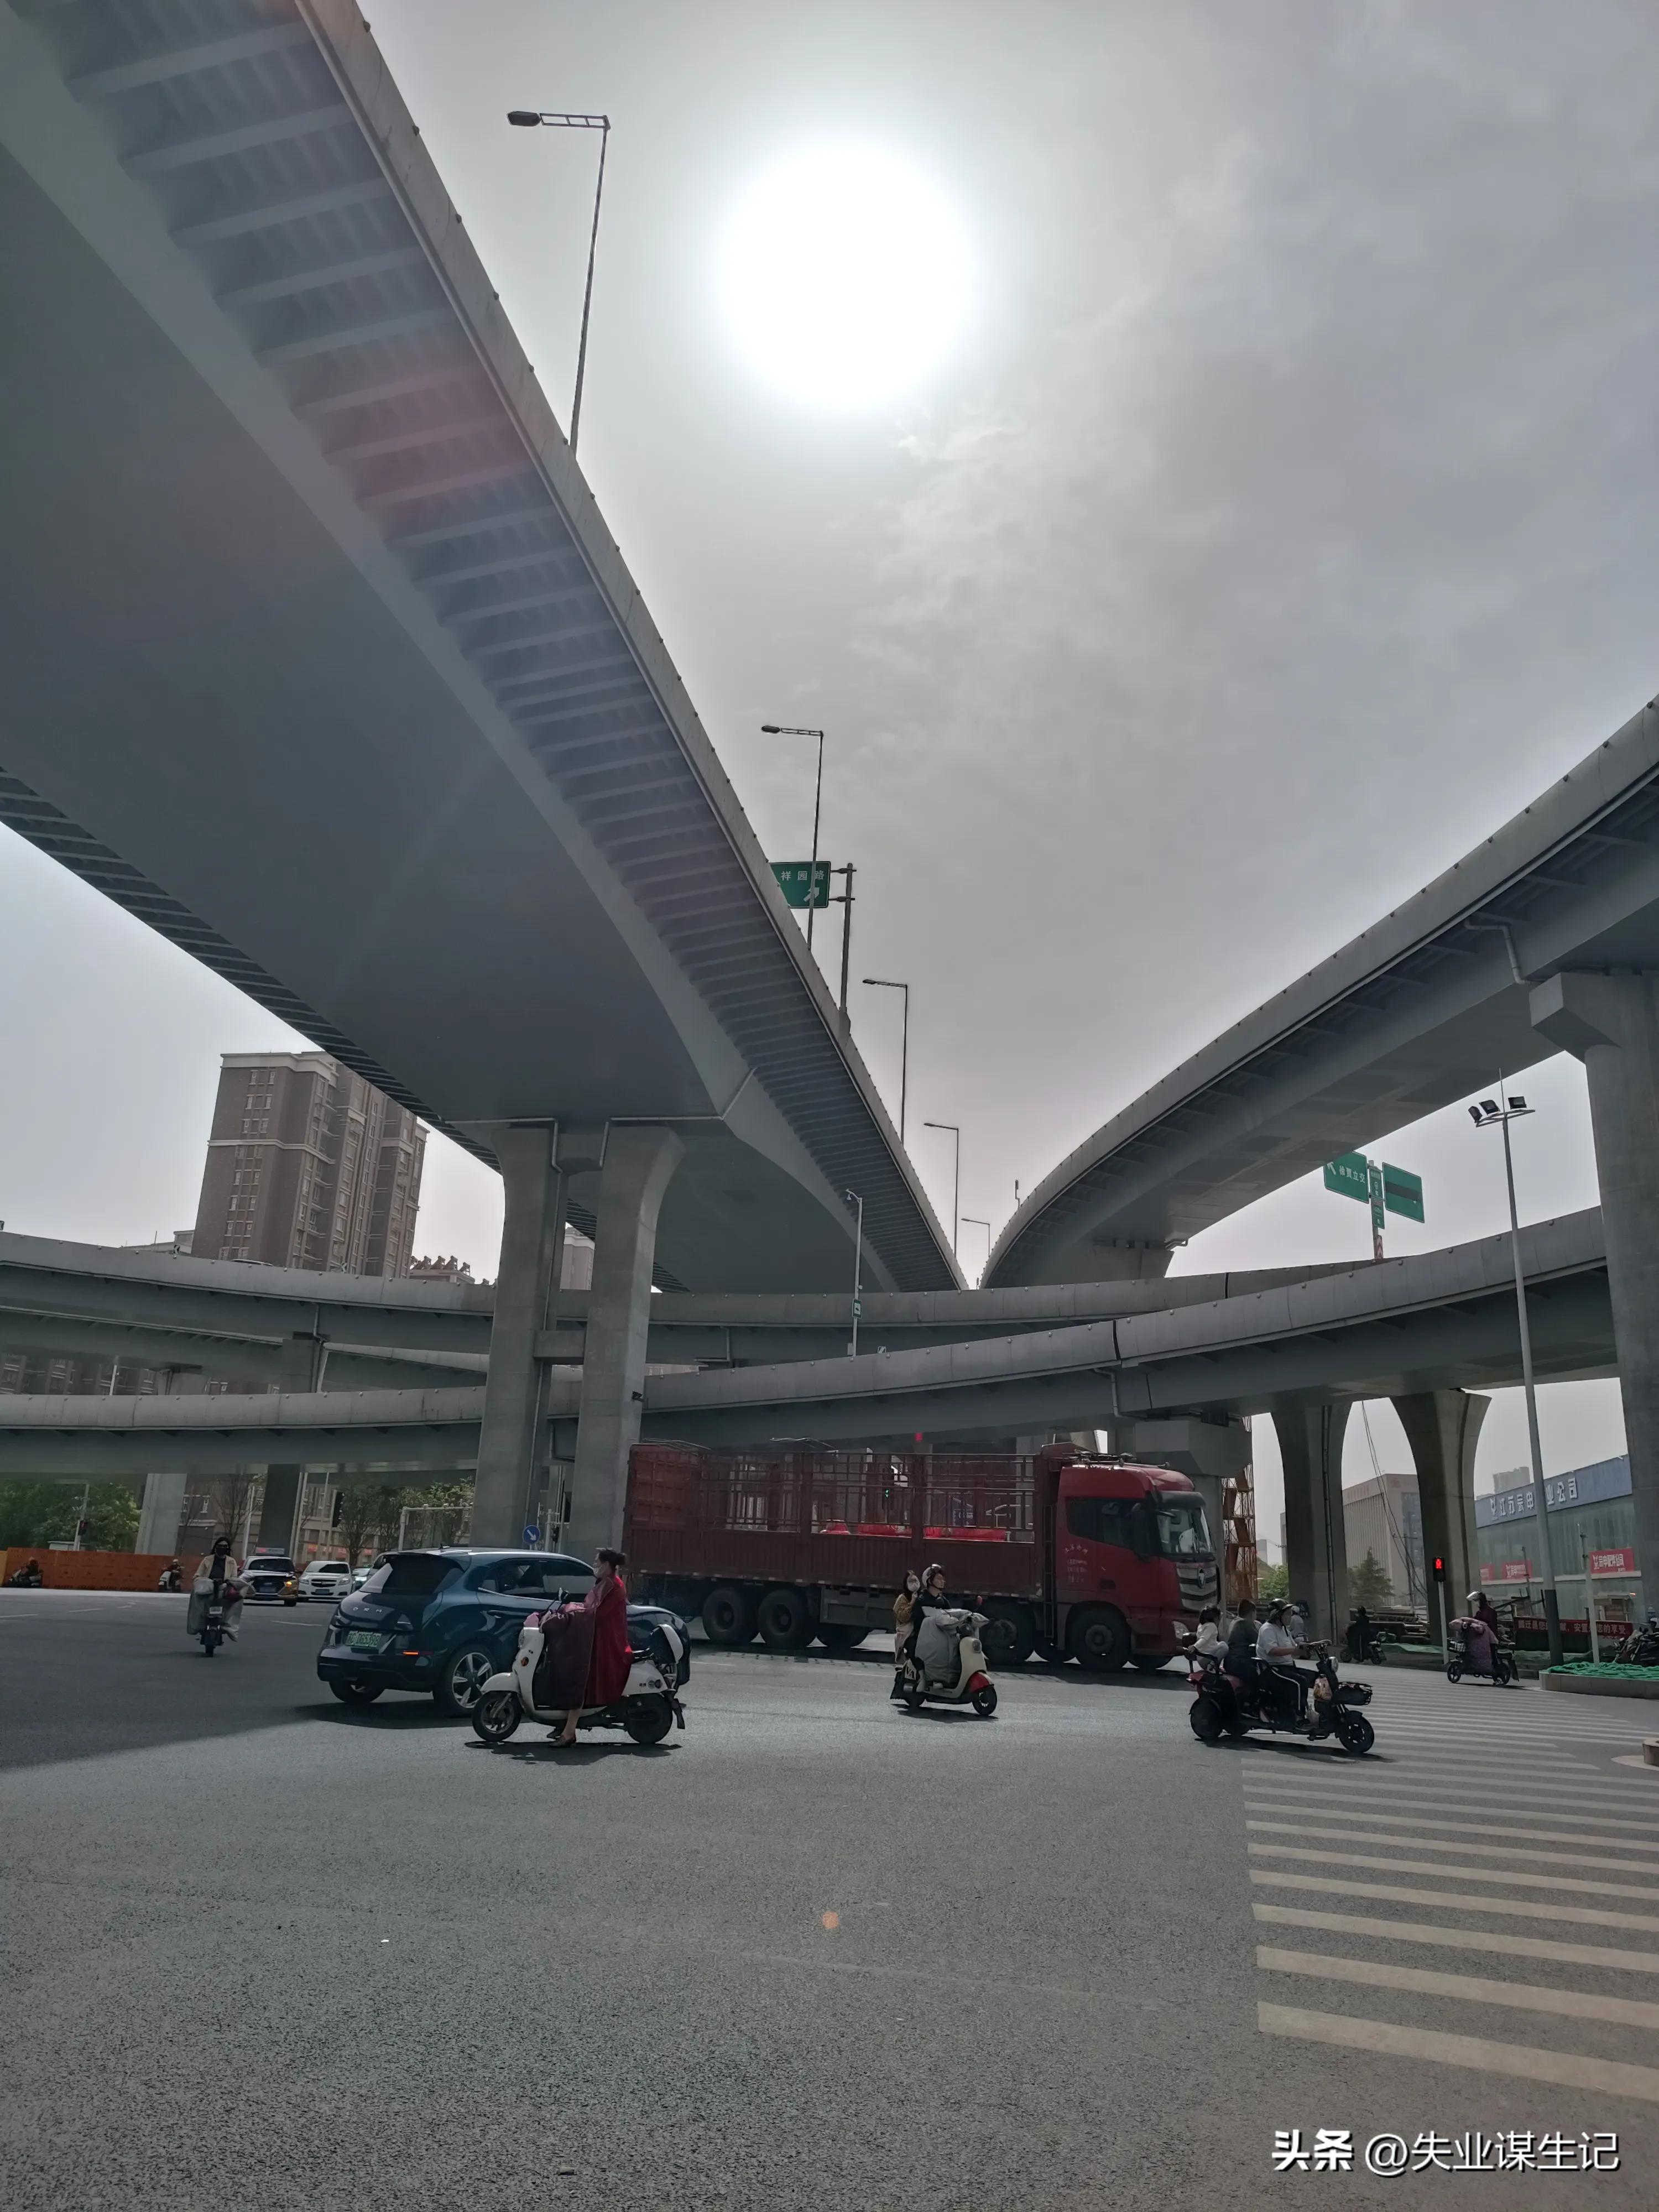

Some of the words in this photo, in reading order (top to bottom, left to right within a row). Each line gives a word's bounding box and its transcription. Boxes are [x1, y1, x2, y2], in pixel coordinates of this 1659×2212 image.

[780, 870, 825, 881] 祥园路
[1499, 1477, 1578, 1516] 江苏宗申业公司
